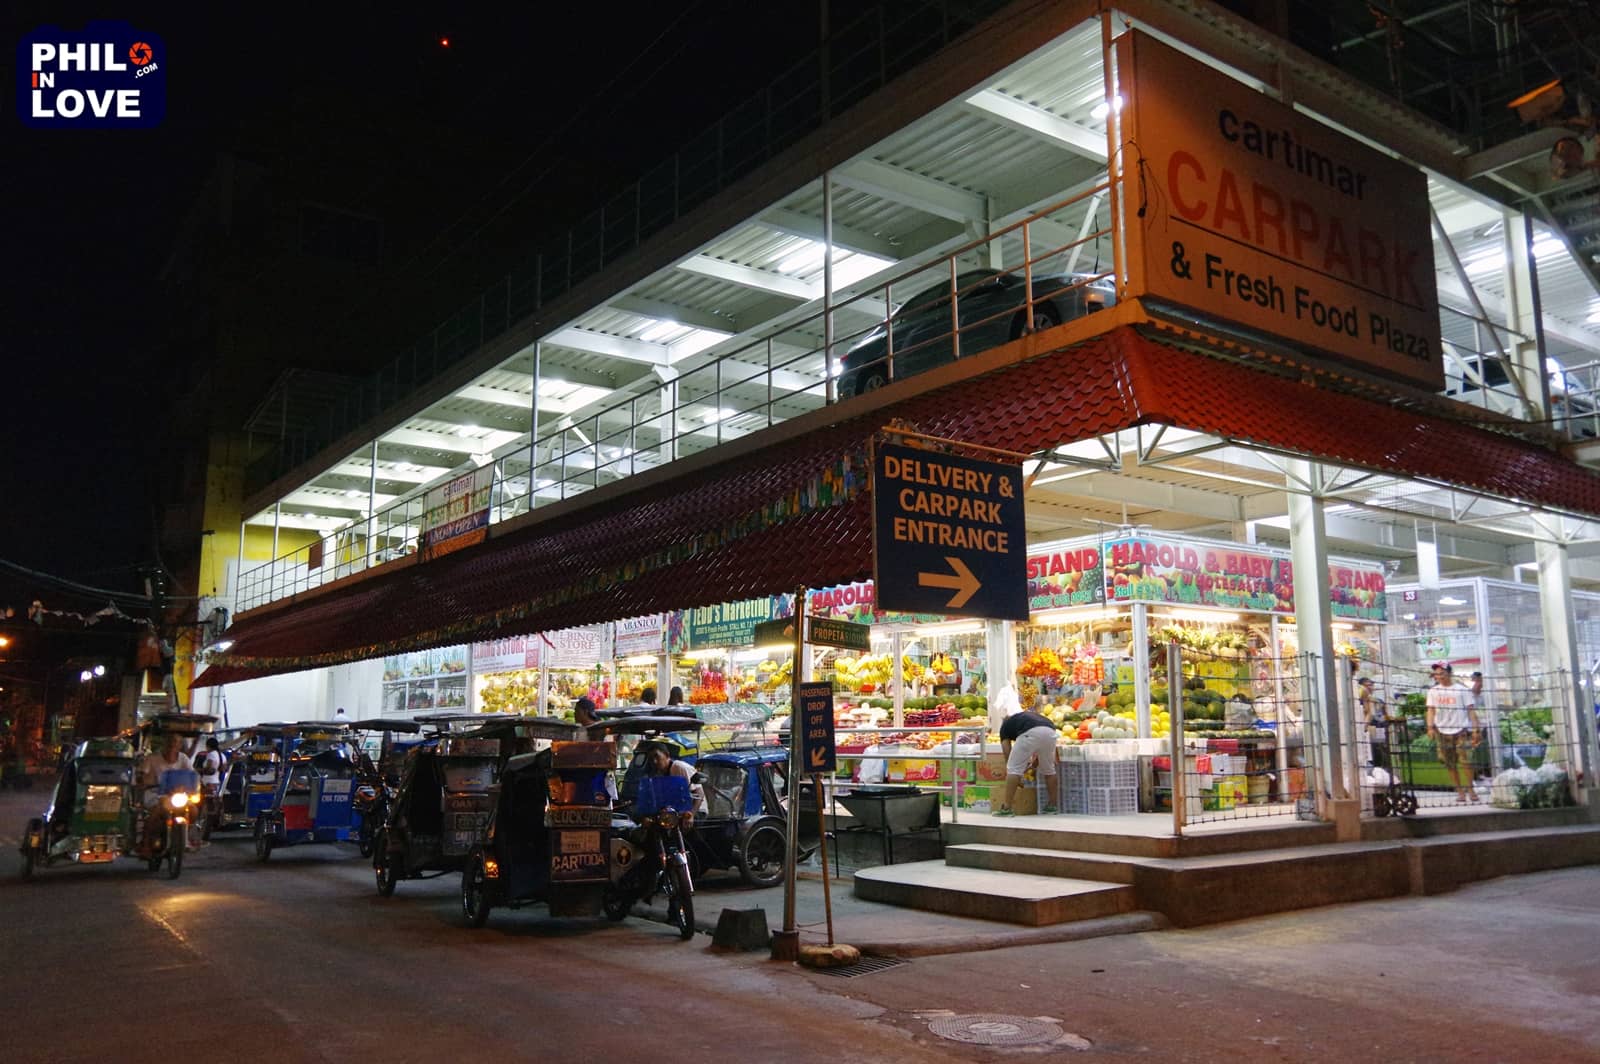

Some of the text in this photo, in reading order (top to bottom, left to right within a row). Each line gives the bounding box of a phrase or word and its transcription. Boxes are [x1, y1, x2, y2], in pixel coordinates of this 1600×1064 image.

[1218, 108, 1368, 201] cartimar
[1167, 150, 1421, 304] CARPARK
[1171, 240, 1431, 361] & Fresh Food Plaza
[884, 456, 1015, 499] DELIVERY &
[899, 488, 1002, 525] CARPARK
[894, 517, 1009, 554] ENTRANCE
[1027, 548, 1099, 579] STAND
[1112, 542, 1198, 573] HAROLD
[1205, 551, 1220, 573] &
[1226, 554, 1274, 579] BABY
[1337, 569, 1386, 593] STAND
[722, 597, 771, 622] Marketing
[812, 584, 875, 609] HAROLD
[623, 618, 657, 630] ABANICO
[560, 640, 594, 650] STORE
[807, 702, 826, 711] DROP
[810, 715, 823, 725] OFF
[809, 729, 827, 739] AREA
